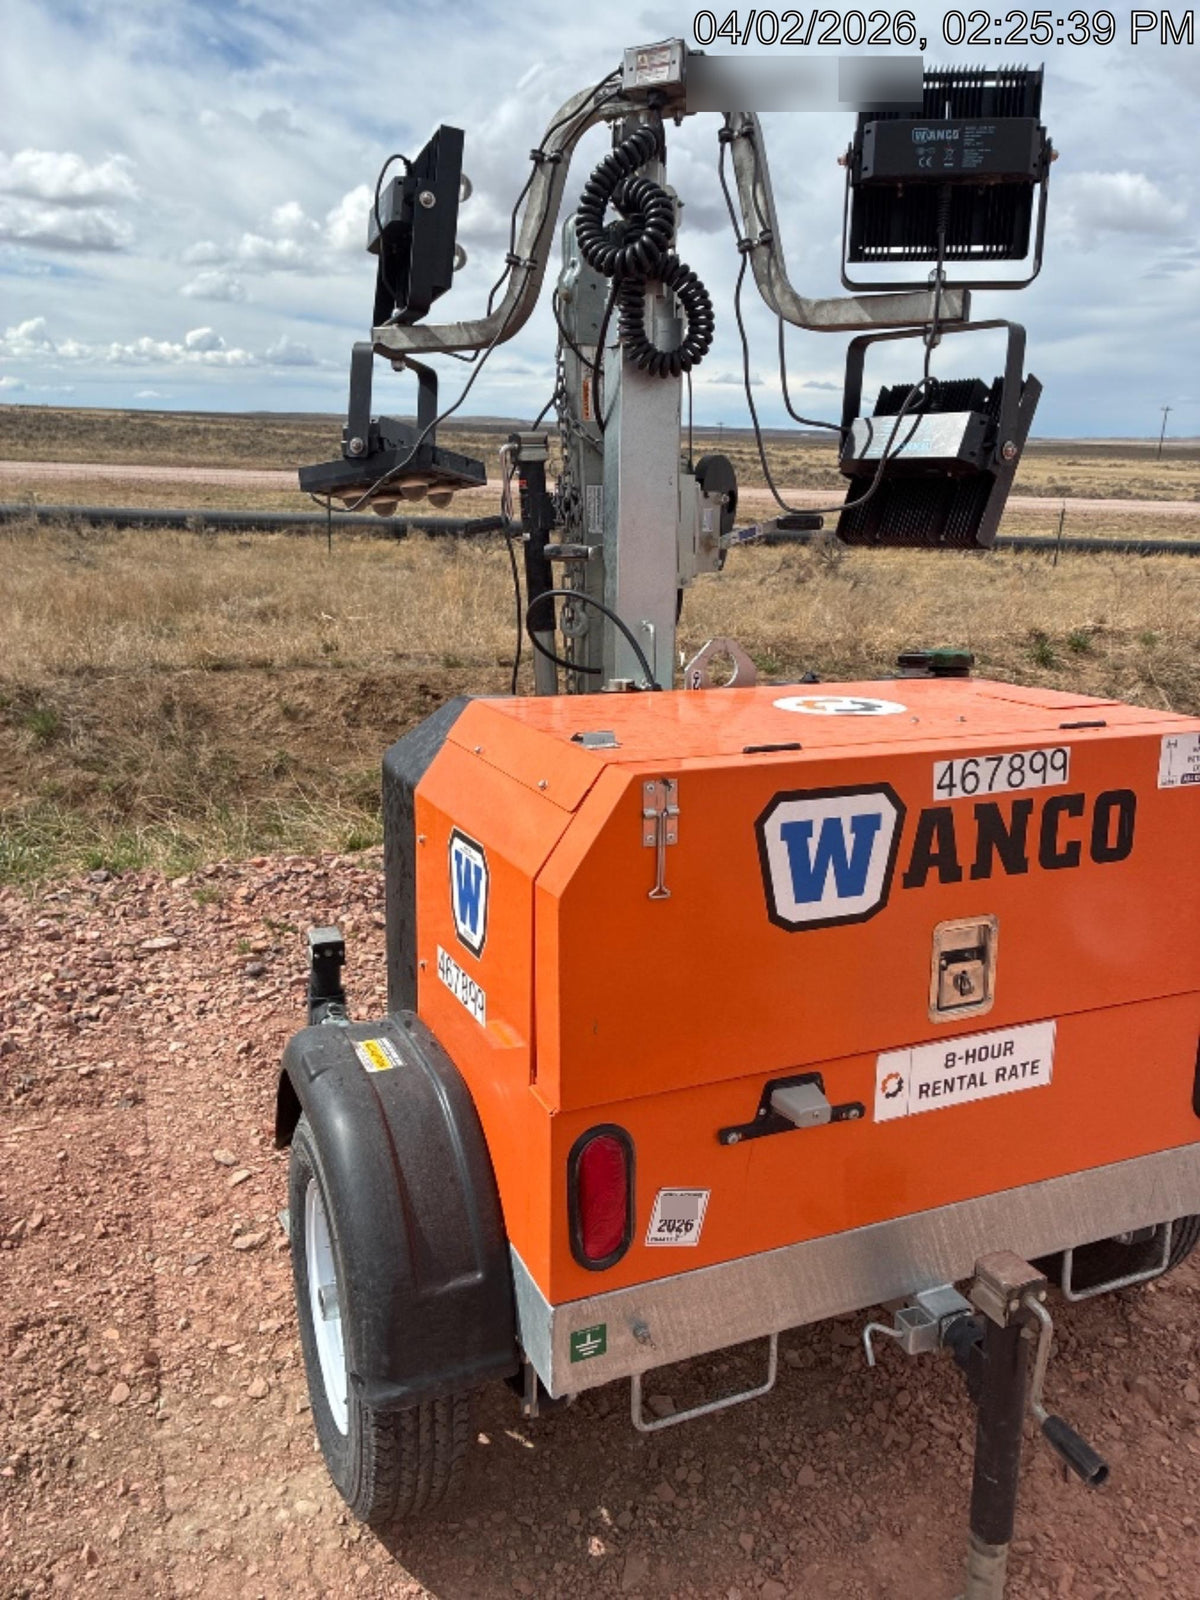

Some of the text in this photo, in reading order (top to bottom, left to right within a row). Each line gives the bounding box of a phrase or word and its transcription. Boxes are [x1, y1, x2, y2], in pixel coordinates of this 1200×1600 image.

[913, 128, 960, 143] WANCO
[936, 748, 1067, 796] 467899
[778, 788, 1137, 905] WANCO
[454, 848, 483, 936] W
[438, 951, 485, 1019] 467899
[944, 1040, 1015, 1069] 8-HOUR
[918, 1059, 1041, 1100] RENTAL RATE
[657, 1218, 694, 1233] 2026
